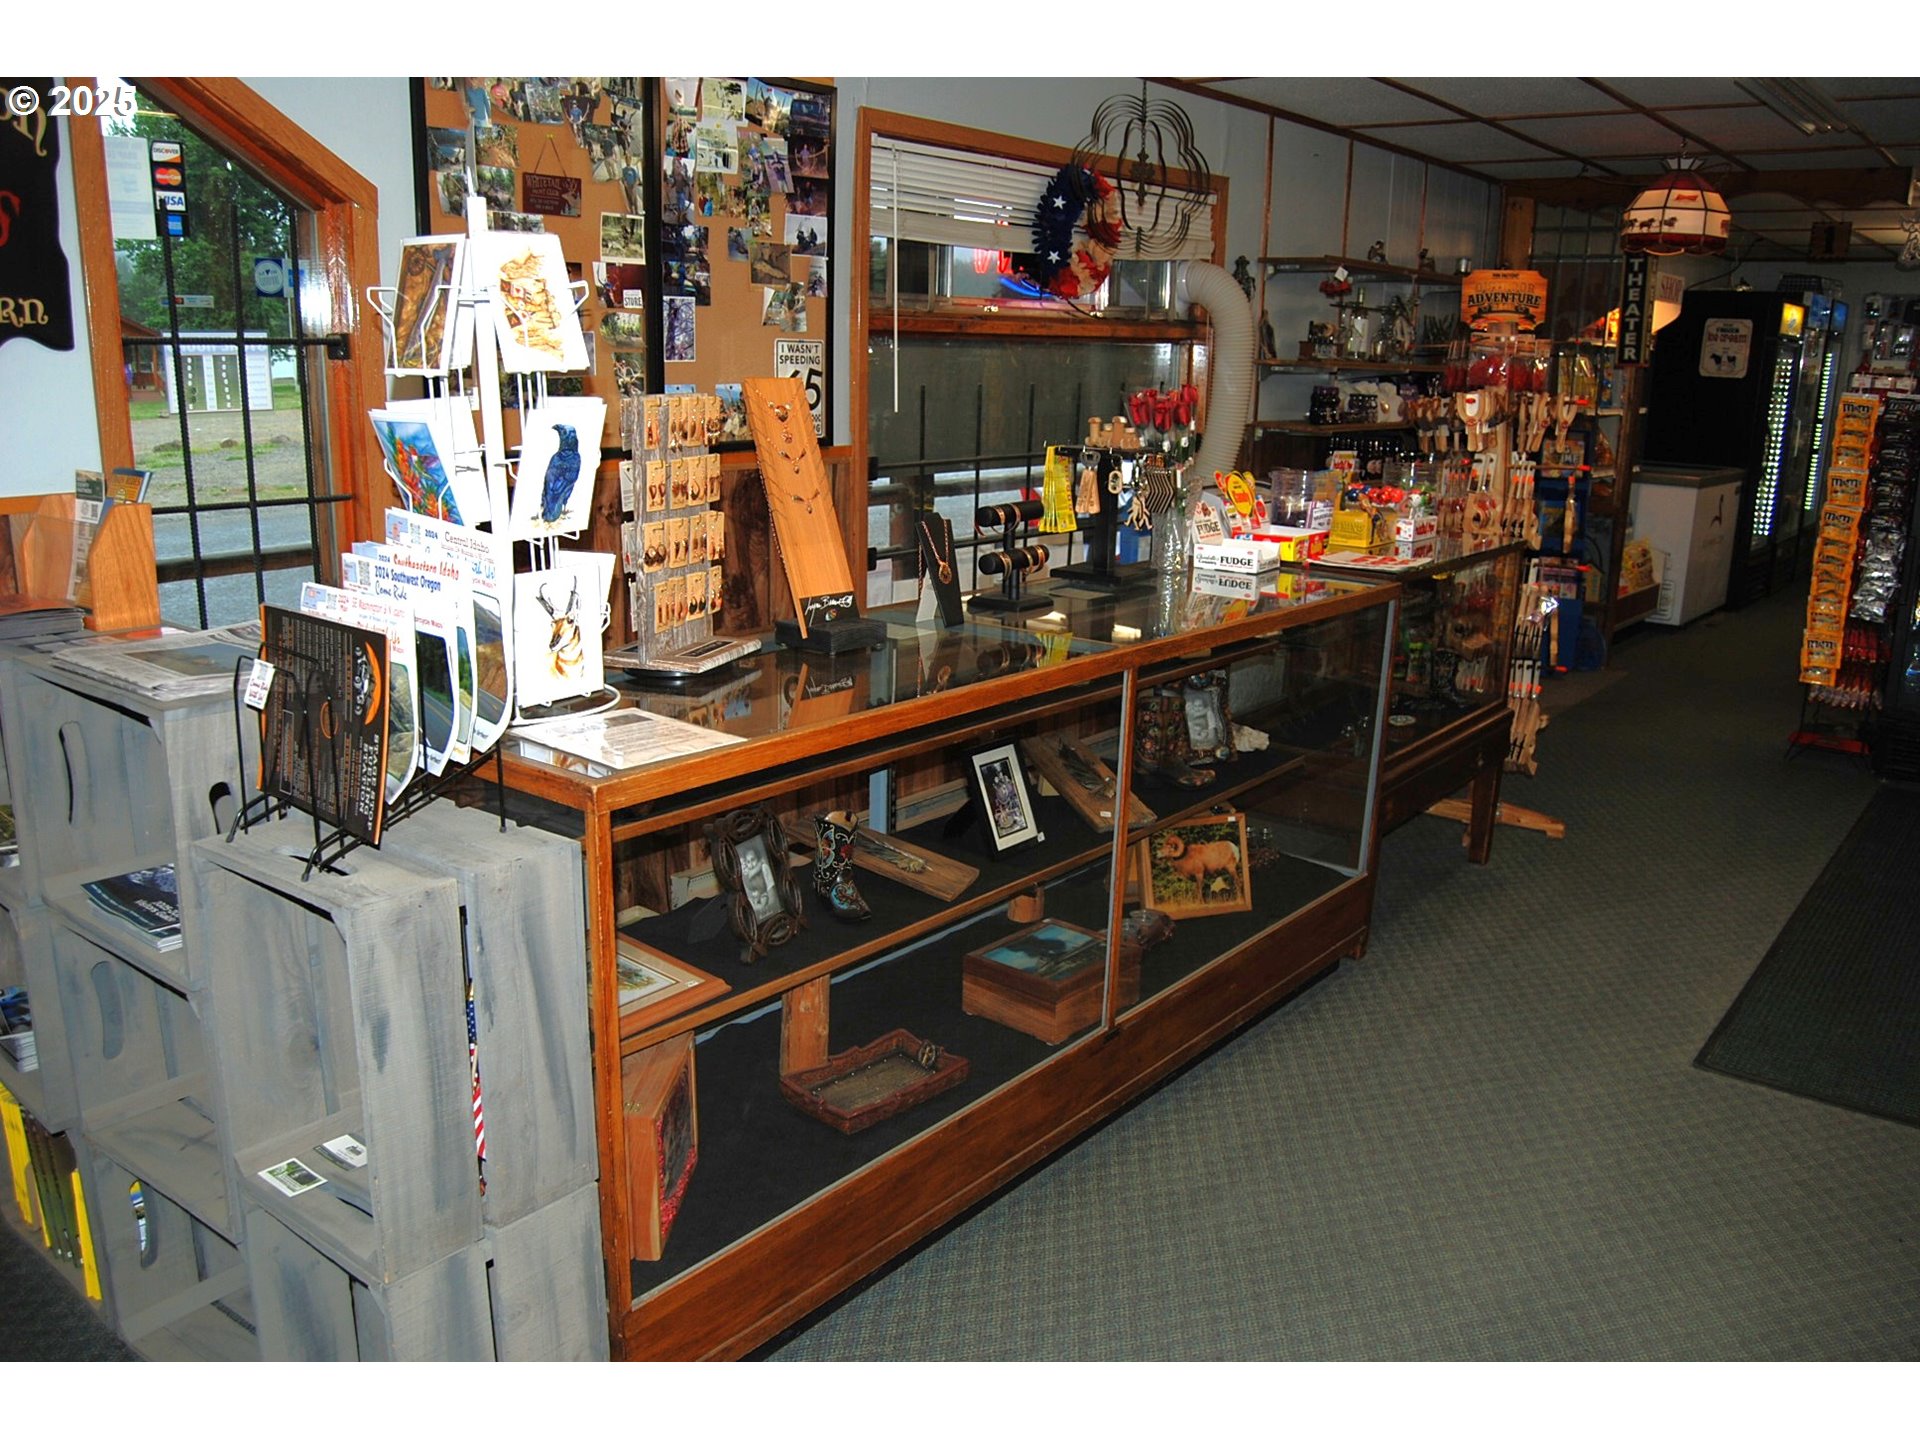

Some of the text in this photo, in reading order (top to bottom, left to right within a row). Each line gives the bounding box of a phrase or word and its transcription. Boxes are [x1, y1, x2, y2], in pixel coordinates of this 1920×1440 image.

[153, 147, 179, 155] DISCOVER
[1467, 292, 1542, 308] ADVENTURE
[1624, 257, 1644, 360] THEATER
[786, 343, 819, 354] WASN'T
[779, 354, 820, 365] SPEEDING
[424, 528, 438, 540] 2024
[1196, 521, 1221, 535] FUDGE
[1219, 555, 1254, 567] FUDGE
[439, 560, 459, 581] Idaho
[374, 565, 441, 593] 2024 Southwest Oregon
[359, 742, 369, 814] STATION
[364, 745, 374, 815] FUELING
[367, 734, 380, 832] STAGE STOP
